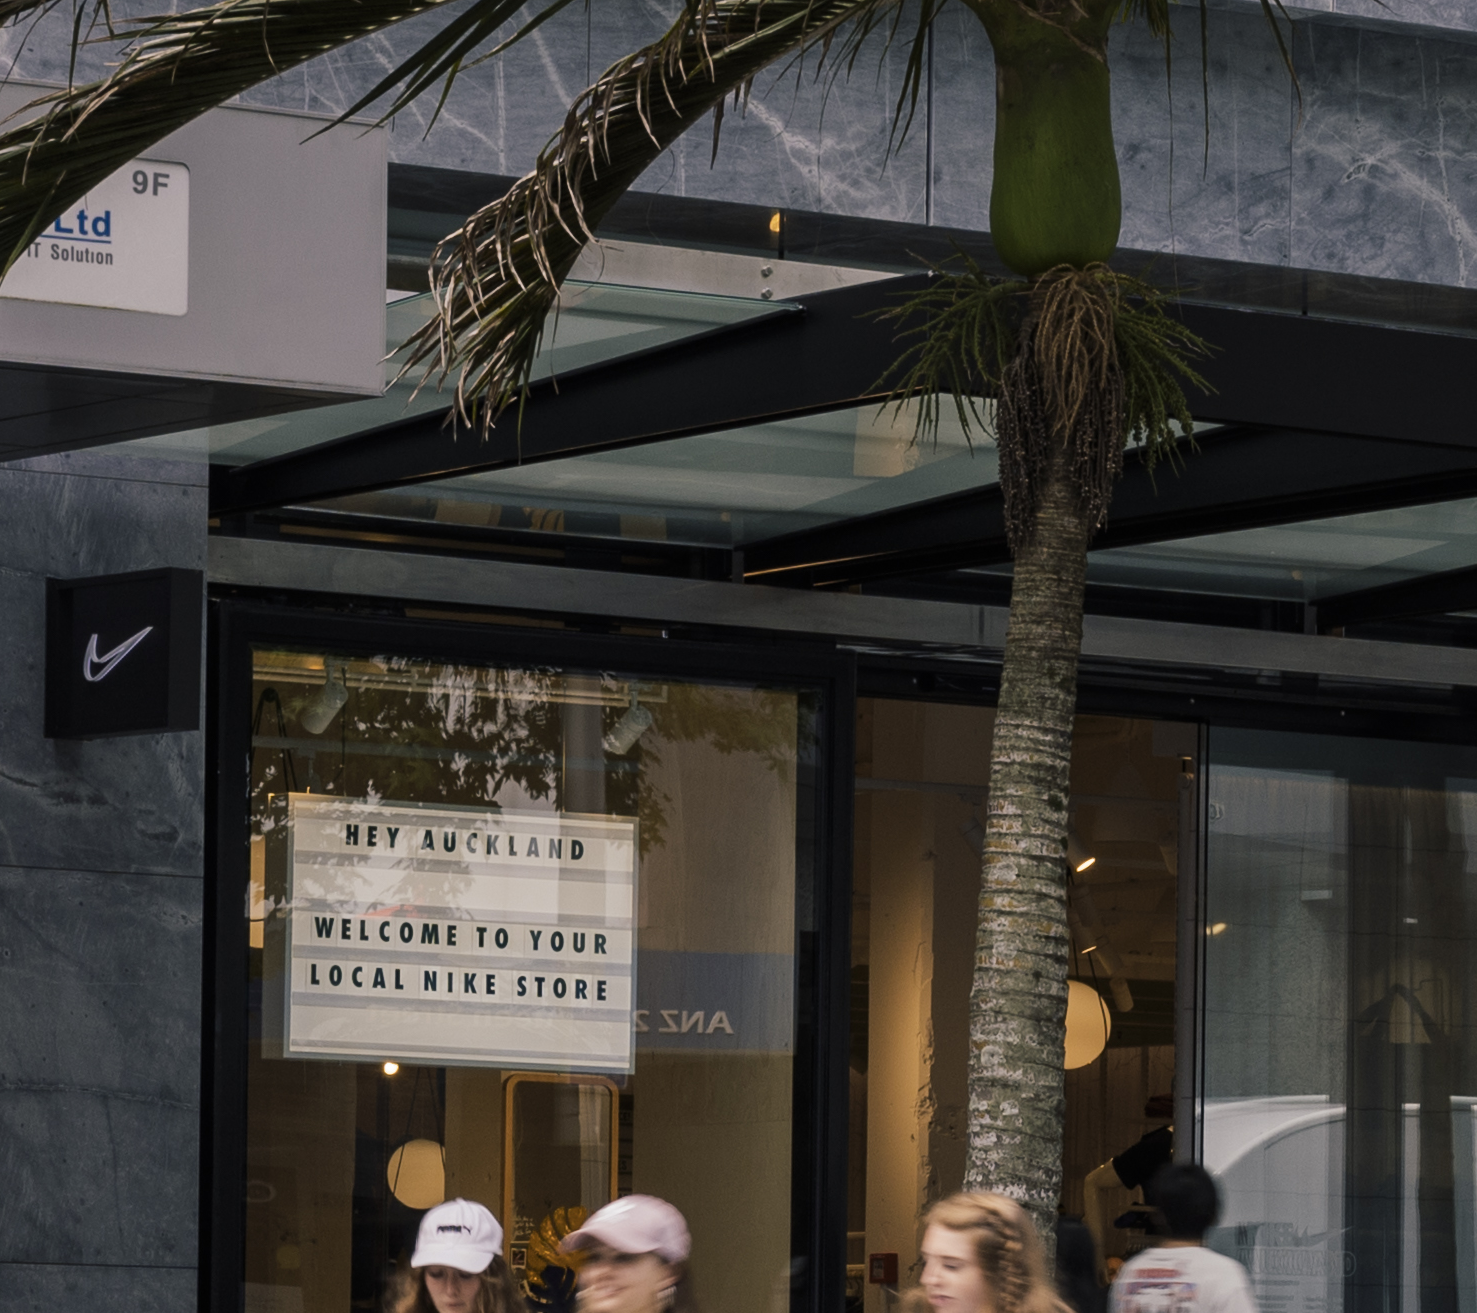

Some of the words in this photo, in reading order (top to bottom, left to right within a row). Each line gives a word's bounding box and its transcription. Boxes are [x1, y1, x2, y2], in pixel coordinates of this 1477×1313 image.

[132, 169, 171, 197] 9F
[53, 209, 112, 238] Ltd
[50, 243, 114, 266] Solution
[345, 824, 400, 850] HEY
[421, 829, 585, 861] AUCKLAND
[314, 917, 458, 947] WELCOME
[476, 926, 509, 950] TO
[529, 930, 608, 955] YOUR
[310, 964, 405, 990] LOCAL
[423, 970, 497, 996] NIKE
[516, 976, 608, 1002] STORE
